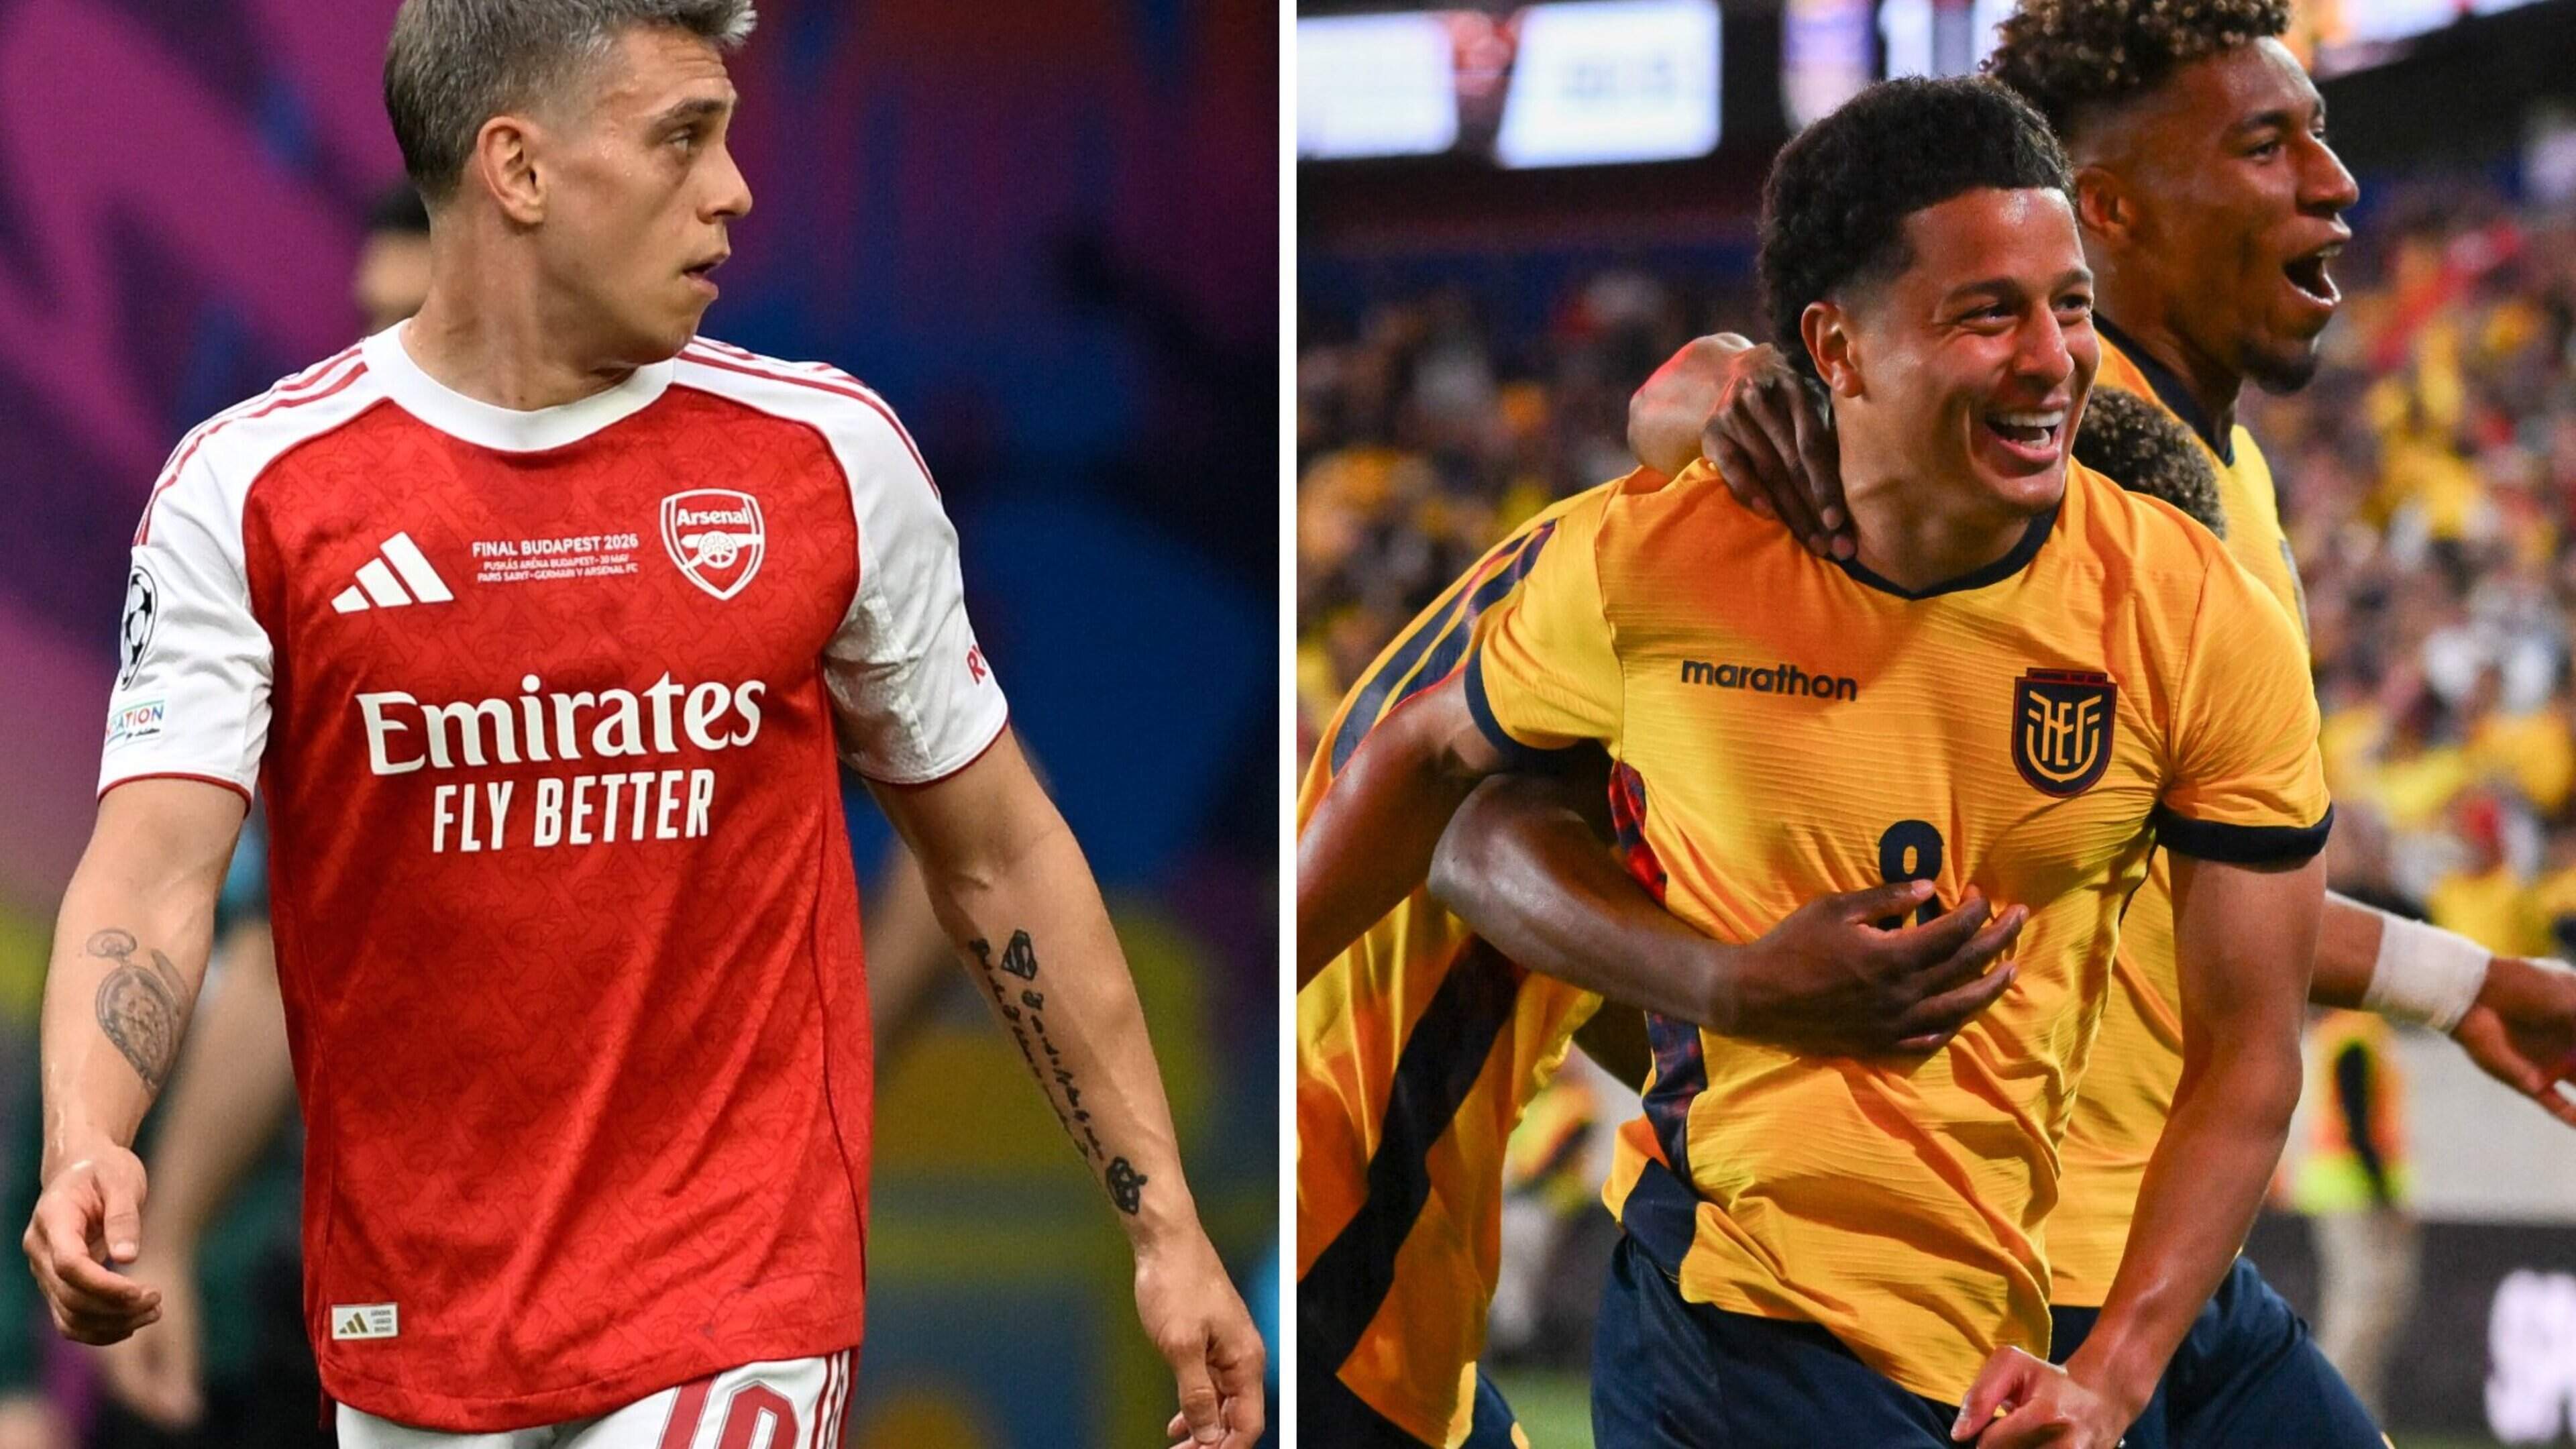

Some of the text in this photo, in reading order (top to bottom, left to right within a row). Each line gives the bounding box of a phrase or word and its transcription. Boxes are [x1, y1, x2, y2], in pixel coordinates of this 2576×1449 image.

[677, 507, 751, 527] Arsenal
[472, 533, 639, 557] FINAL BUDAPEST 2026
[625, 562, 639, 573] FC
[1681, 659, 1858, 702] marathon
[356, 671, 766, 775] Emirates
[432, 768, 715, 853] FLY BETTER
